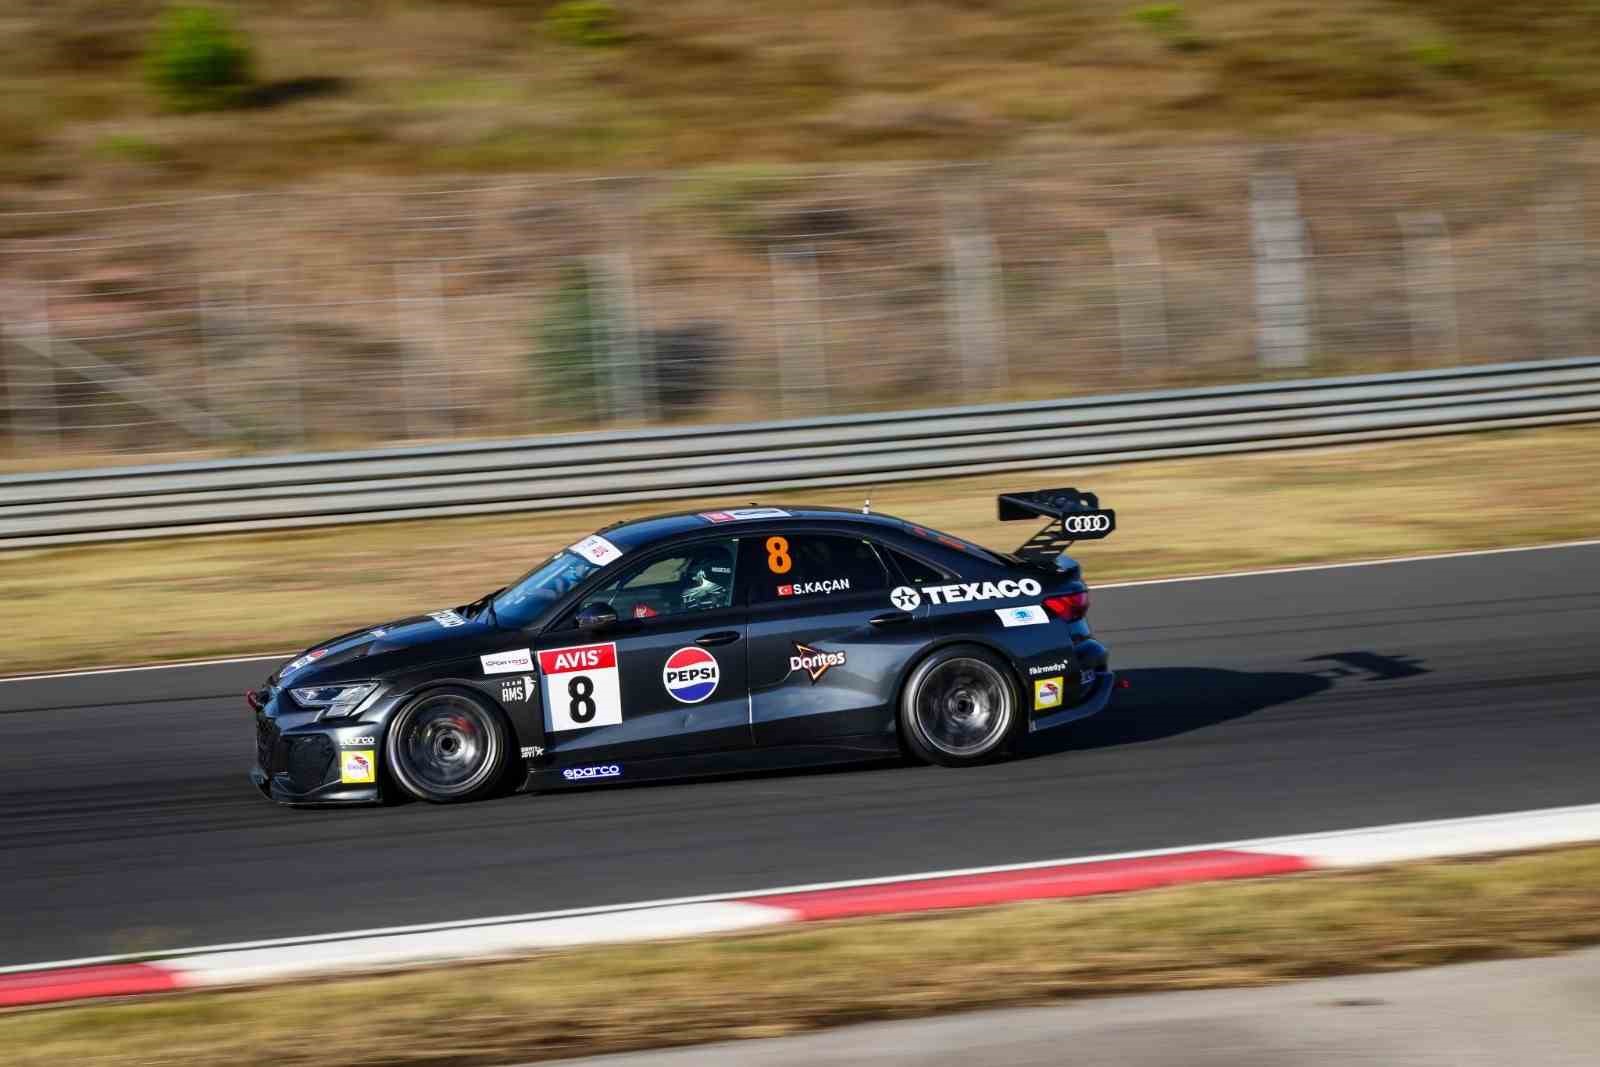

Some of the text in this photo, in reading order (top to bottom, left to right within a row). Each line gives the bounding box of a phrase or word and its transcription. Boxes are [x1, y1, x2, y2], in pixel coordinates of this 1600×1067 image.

[765, 536, 792, 574] 8
[793, 578, 850, 596] S.KAÇAN
[921, 578, 1042, 605] TEXACO
[554, 649, 600, 670] AVIS
[789, 649, 846, 672] Doritos
[501, 680, 522, 688] TEAM
[667, 666, 716, 683] PEPSI
[502, 687, 524, 703] AMS
[567, 675, 597, 724] 8
[562, 763, 620, 779] sparco
